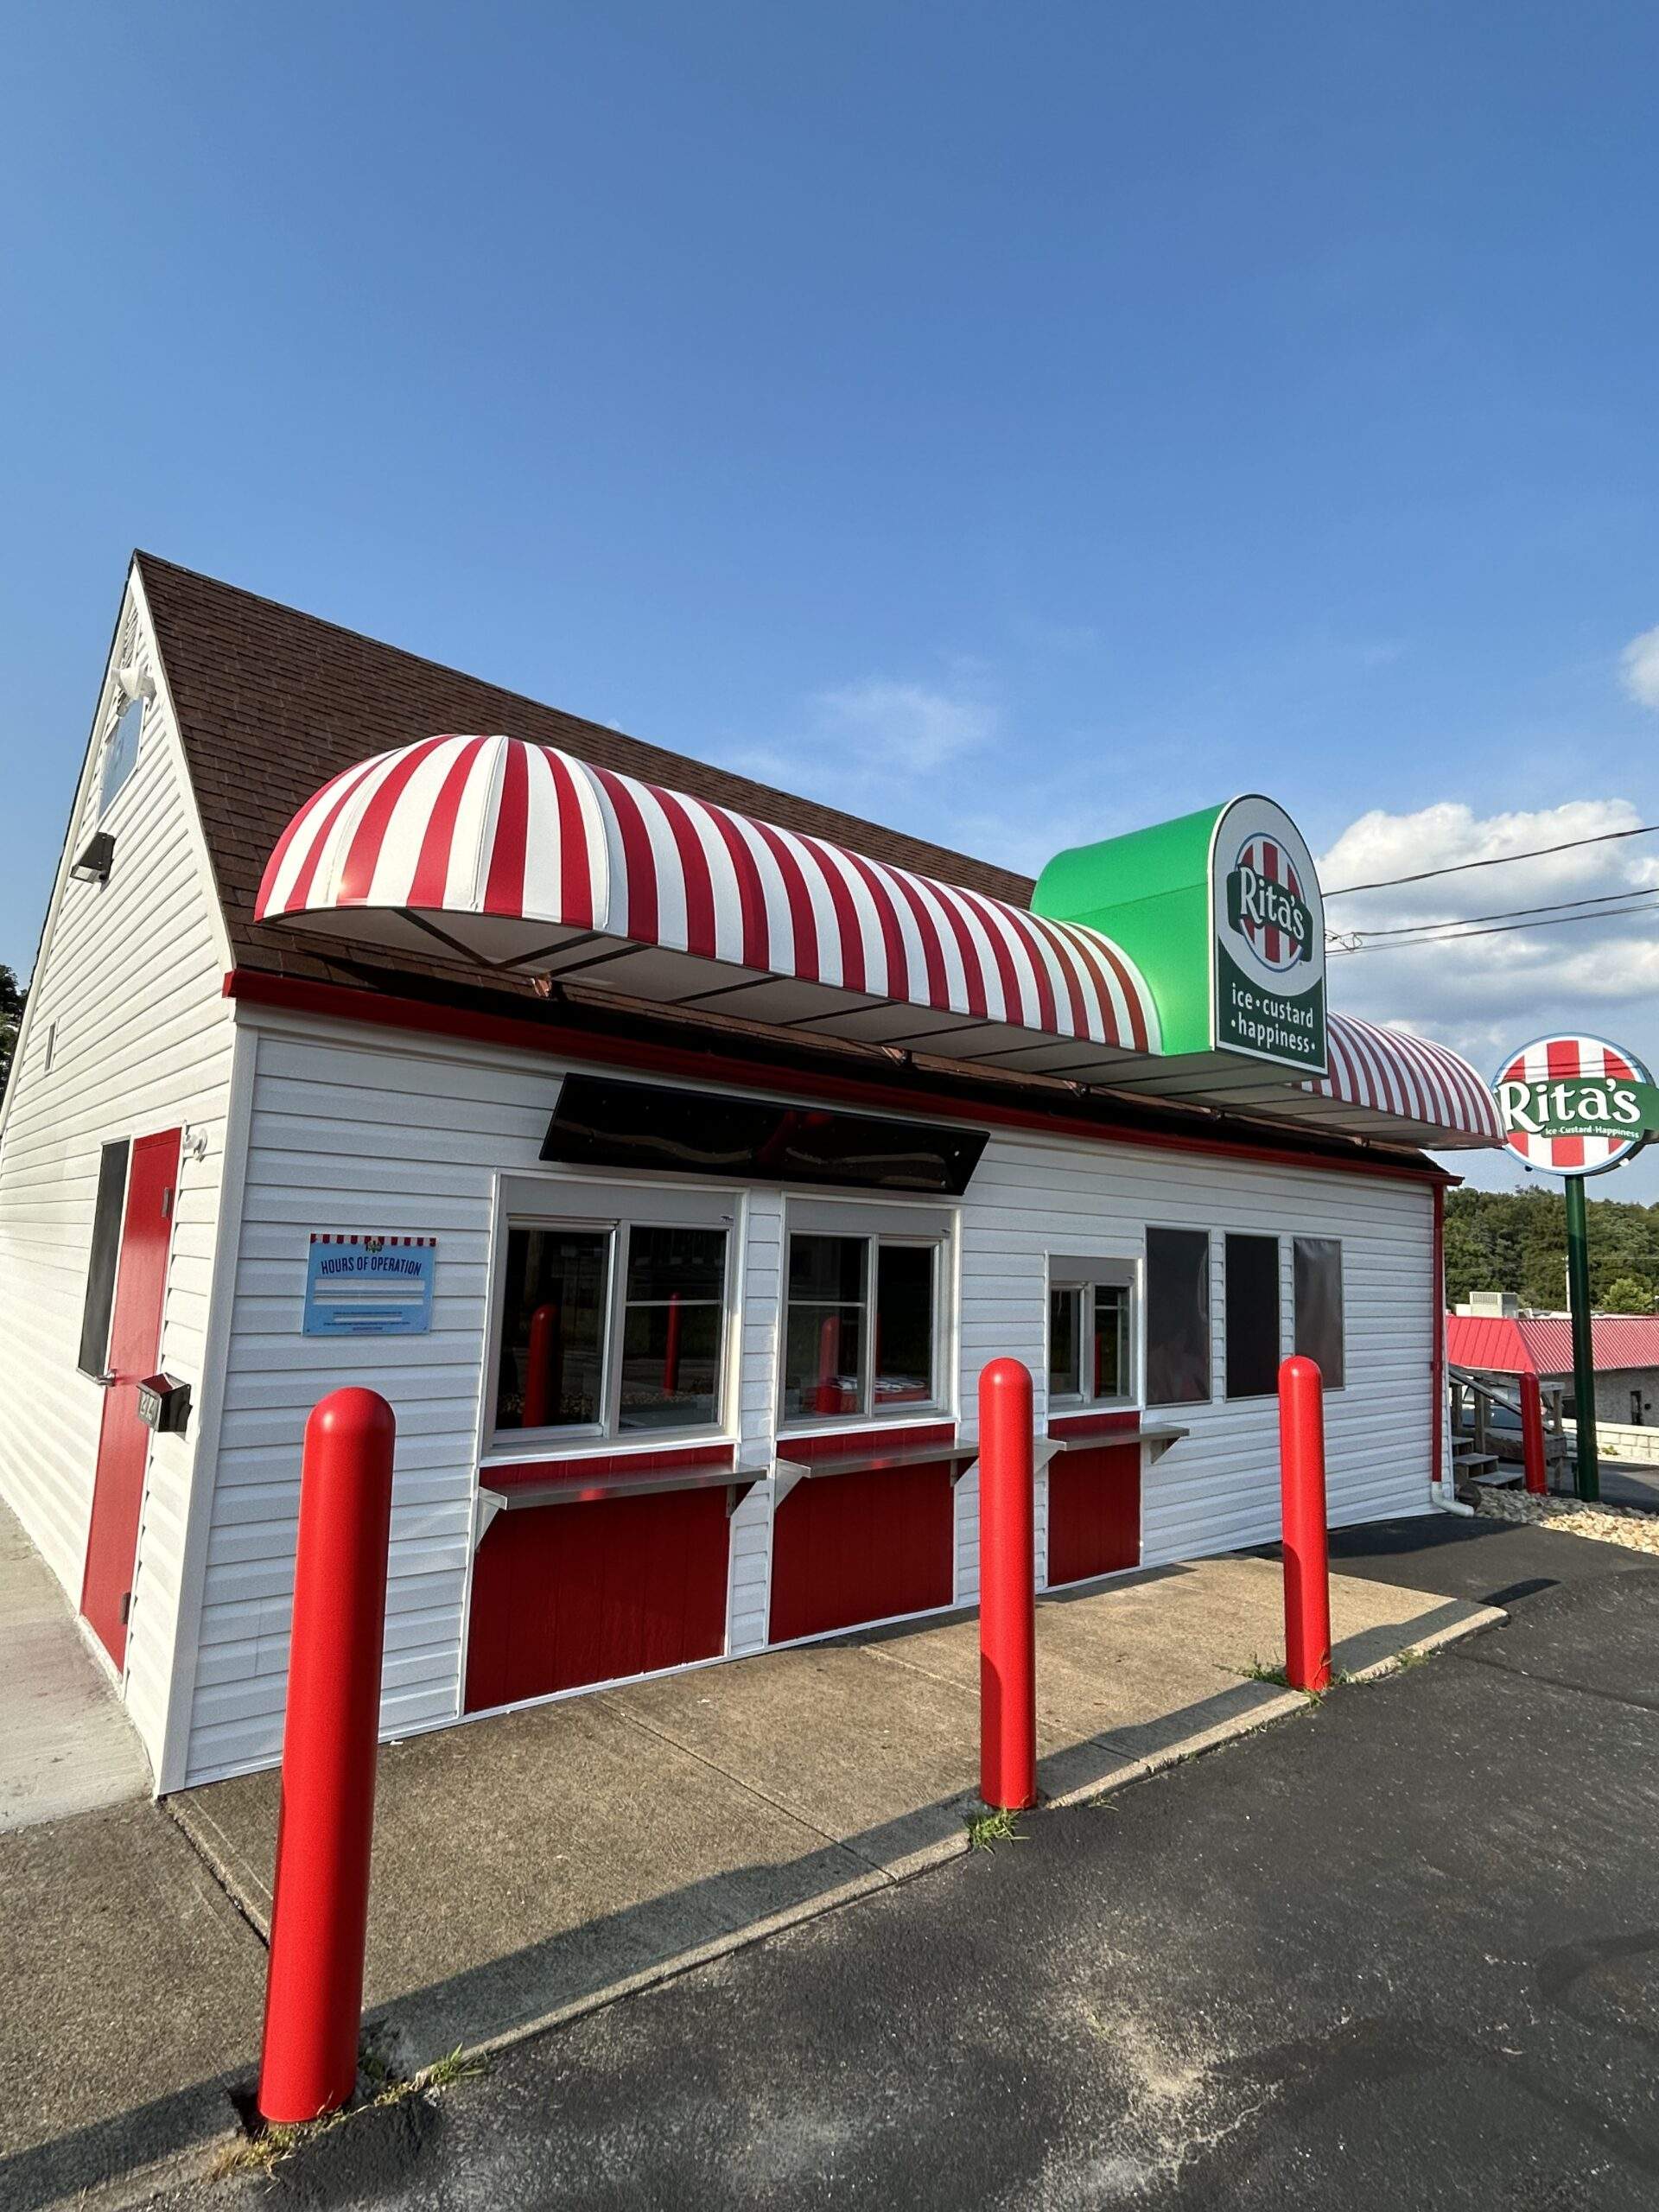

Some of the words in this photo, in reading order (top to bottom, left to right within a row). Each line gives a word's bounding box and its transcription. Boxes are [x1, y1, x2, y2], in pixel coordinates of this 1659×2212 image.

[1240, 867, 1305, 940] Rita's
[1231, 983, 1253, 1010] ice
[1263, 999, 1313, 1028] custard
[1238, 1011, 1310, 1053] happiness
[1497, 1078, 1641, 1133] Rita's
[1595, 1126, 1640, 1139] Happiness
[321, 1257, 354, 1275] HOURS
[357, 1256, 369, 1271] OF
[371, 1256, 423, 1276] OPERATION
